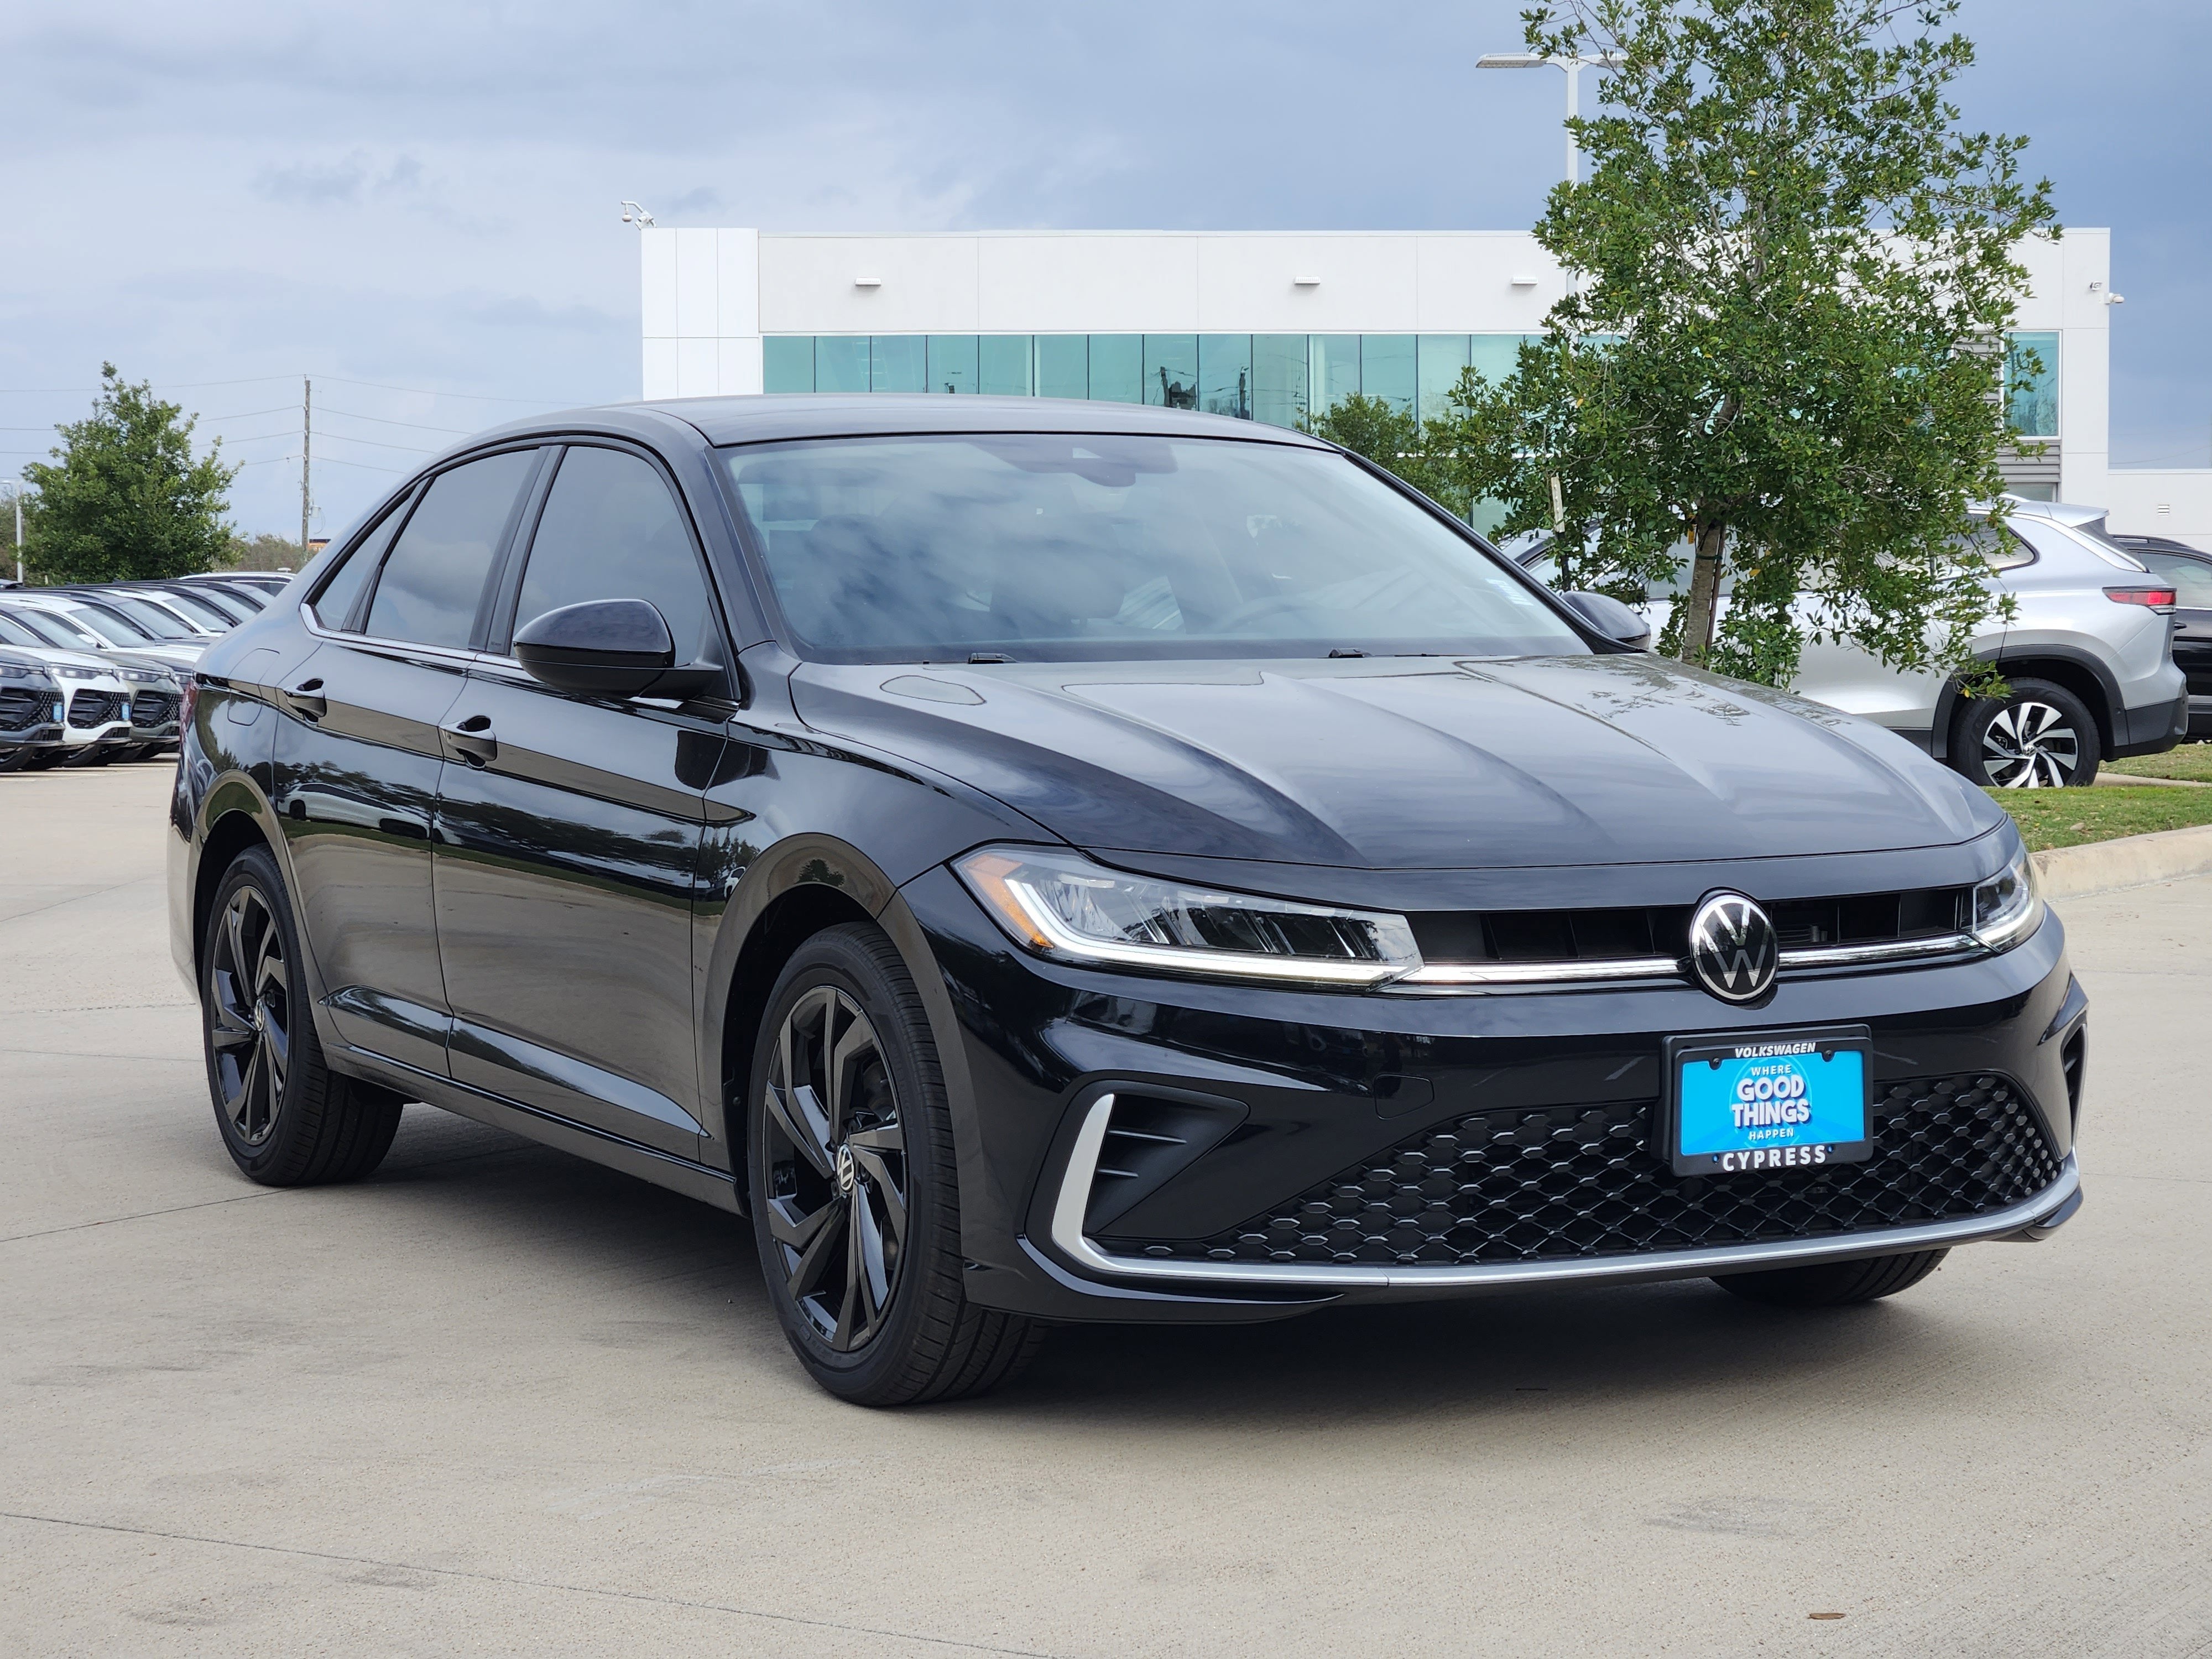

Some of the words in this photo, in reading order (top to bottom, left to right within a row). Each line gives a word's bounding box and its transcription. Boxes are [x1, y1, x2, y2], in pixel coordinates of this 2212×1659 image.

[1735, 1042, 1816, 1058] VOLKSWAGEN
[1751, 1065, 1792, 1076] WHERE
[1737, 1074, 1805, 1102] GOOD
[1731, 1098, 1811, 1128] THINGS
[1749, 1128, 1794, 1140] HAPPEN
[1723, 1145, 1825, 1171] CYPRESS
